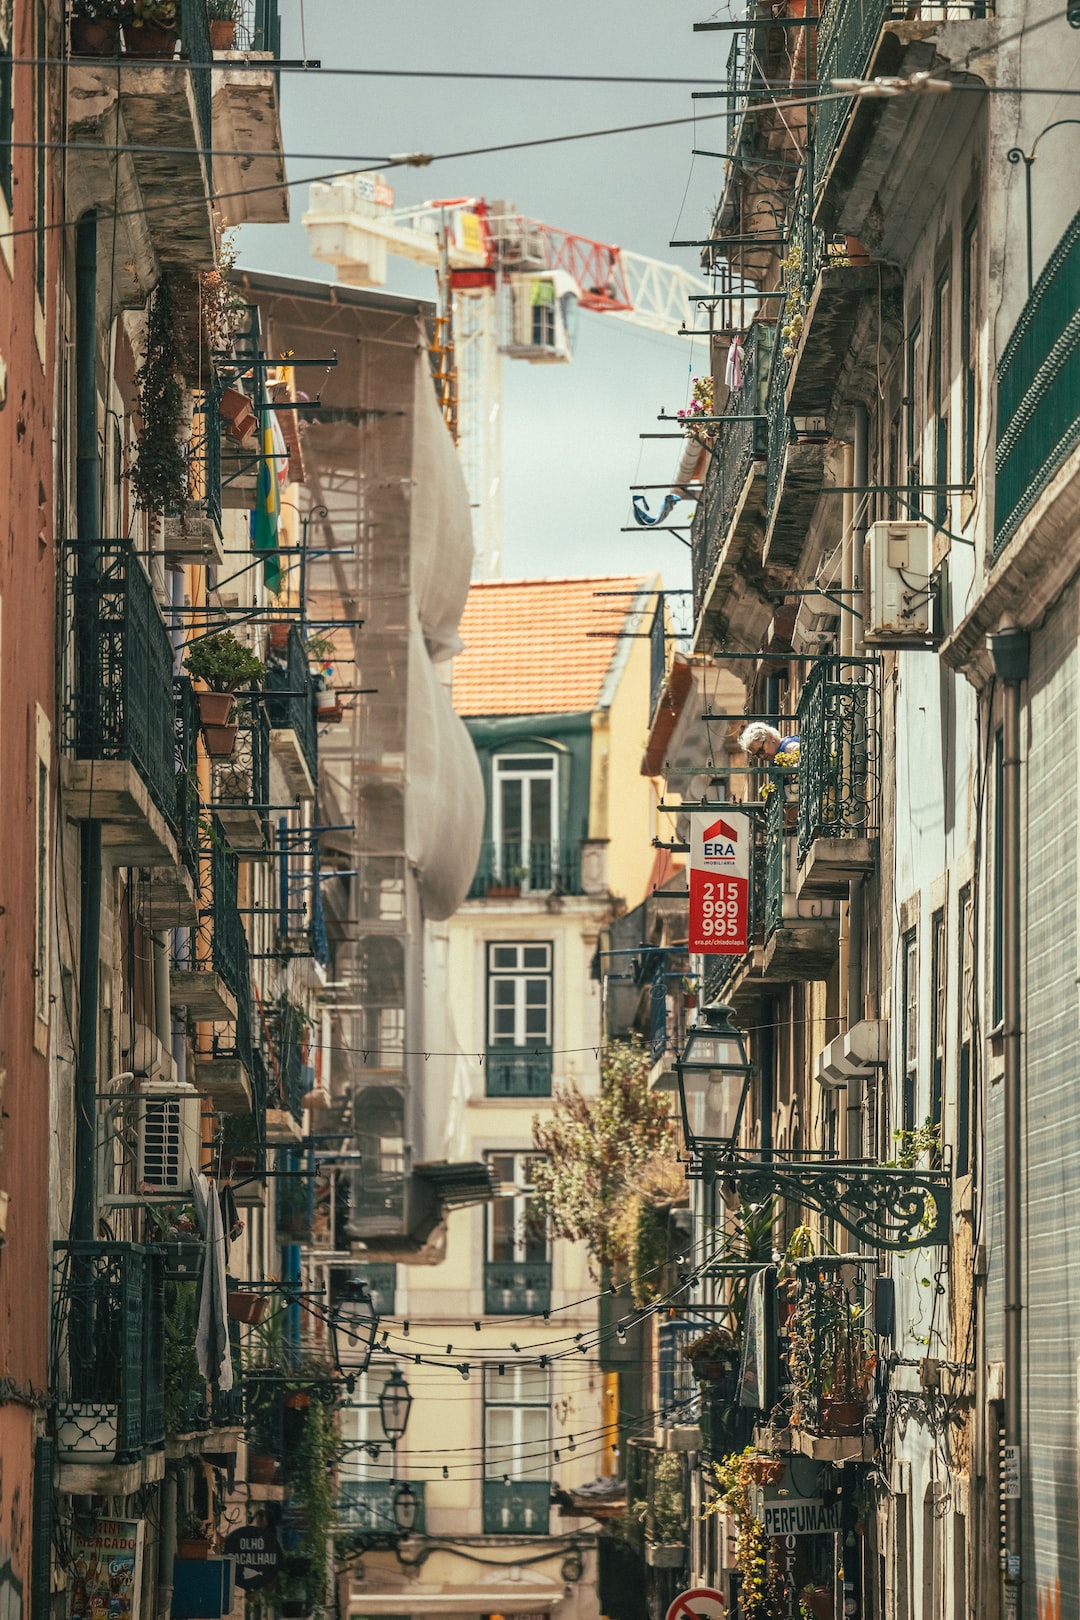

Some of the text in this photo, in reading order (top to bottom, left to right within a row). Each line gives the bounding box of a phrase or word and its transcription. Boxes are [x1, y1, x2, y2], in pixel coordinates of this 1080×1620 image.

[704, 843, 735, 856] ERA
[703, 882, 738, 900] 215
[703, 901, 738, 918] 999
[702, 918, 738, 936] 995
[76, 1536, 136, 1550] MERCADO
[233, 1553, 277, 1565] ACALHAU
